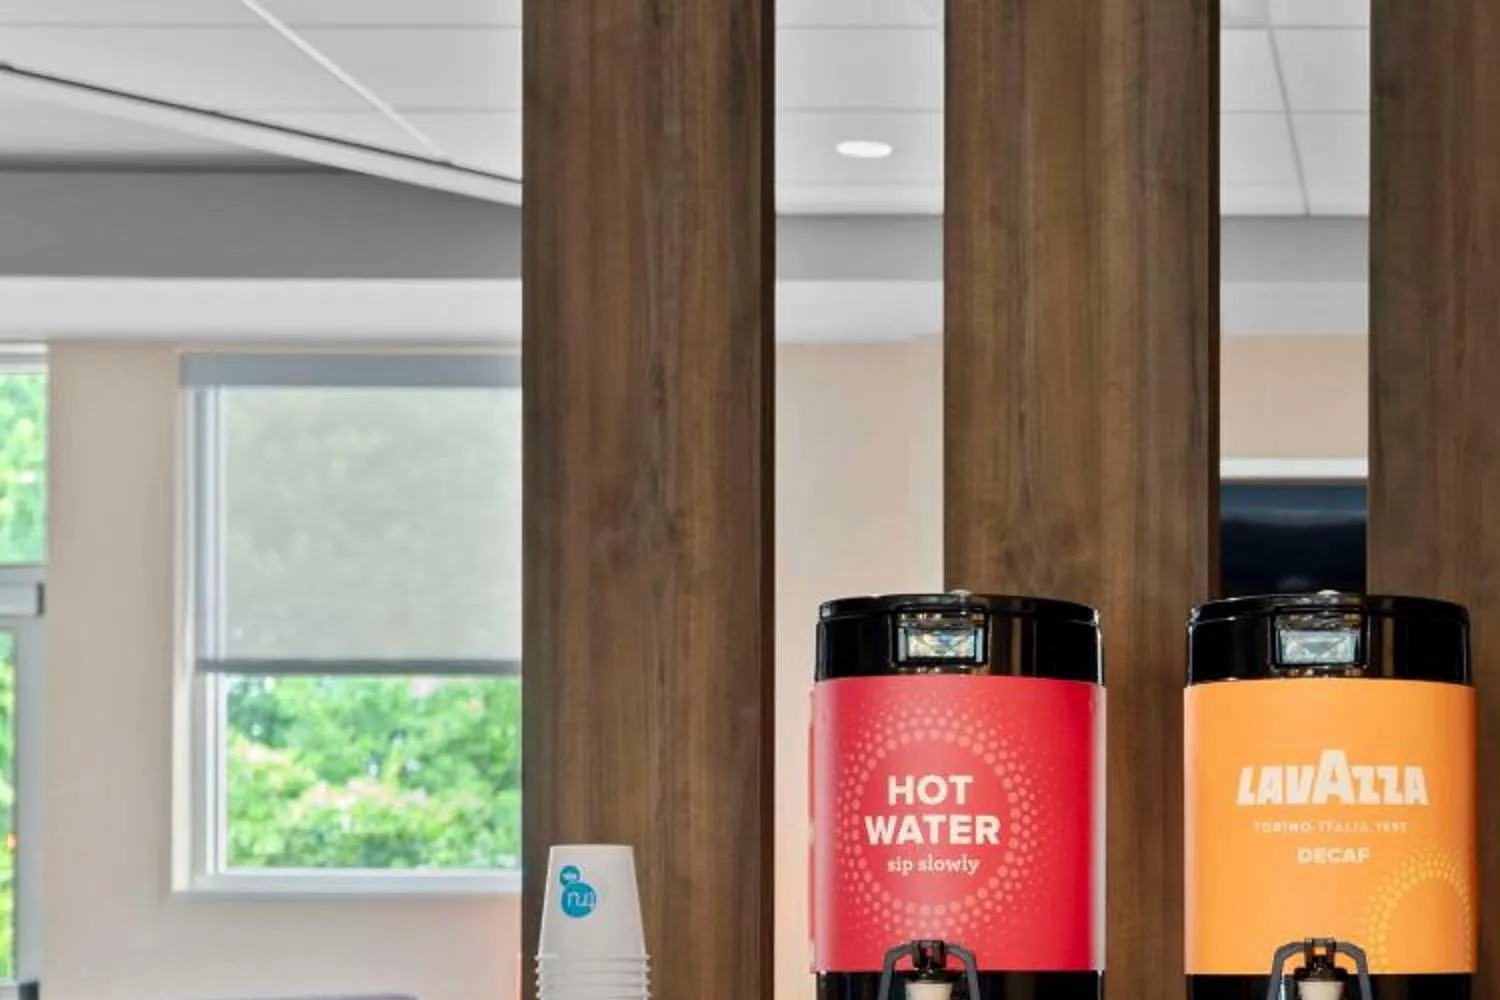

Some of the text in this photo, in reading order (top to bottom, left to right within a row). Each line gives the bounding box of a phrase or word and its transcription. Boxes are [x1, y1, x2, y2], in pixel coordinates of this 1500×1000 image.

[887, 773, 974, 806] HOT
[1236, 748, 1429, 806] LAVAZZA
[864, 814, 1001, 845] WATER
[887, 852, 980, 876] sip slowly
[1297, 848, 1370, 865] DECAF
